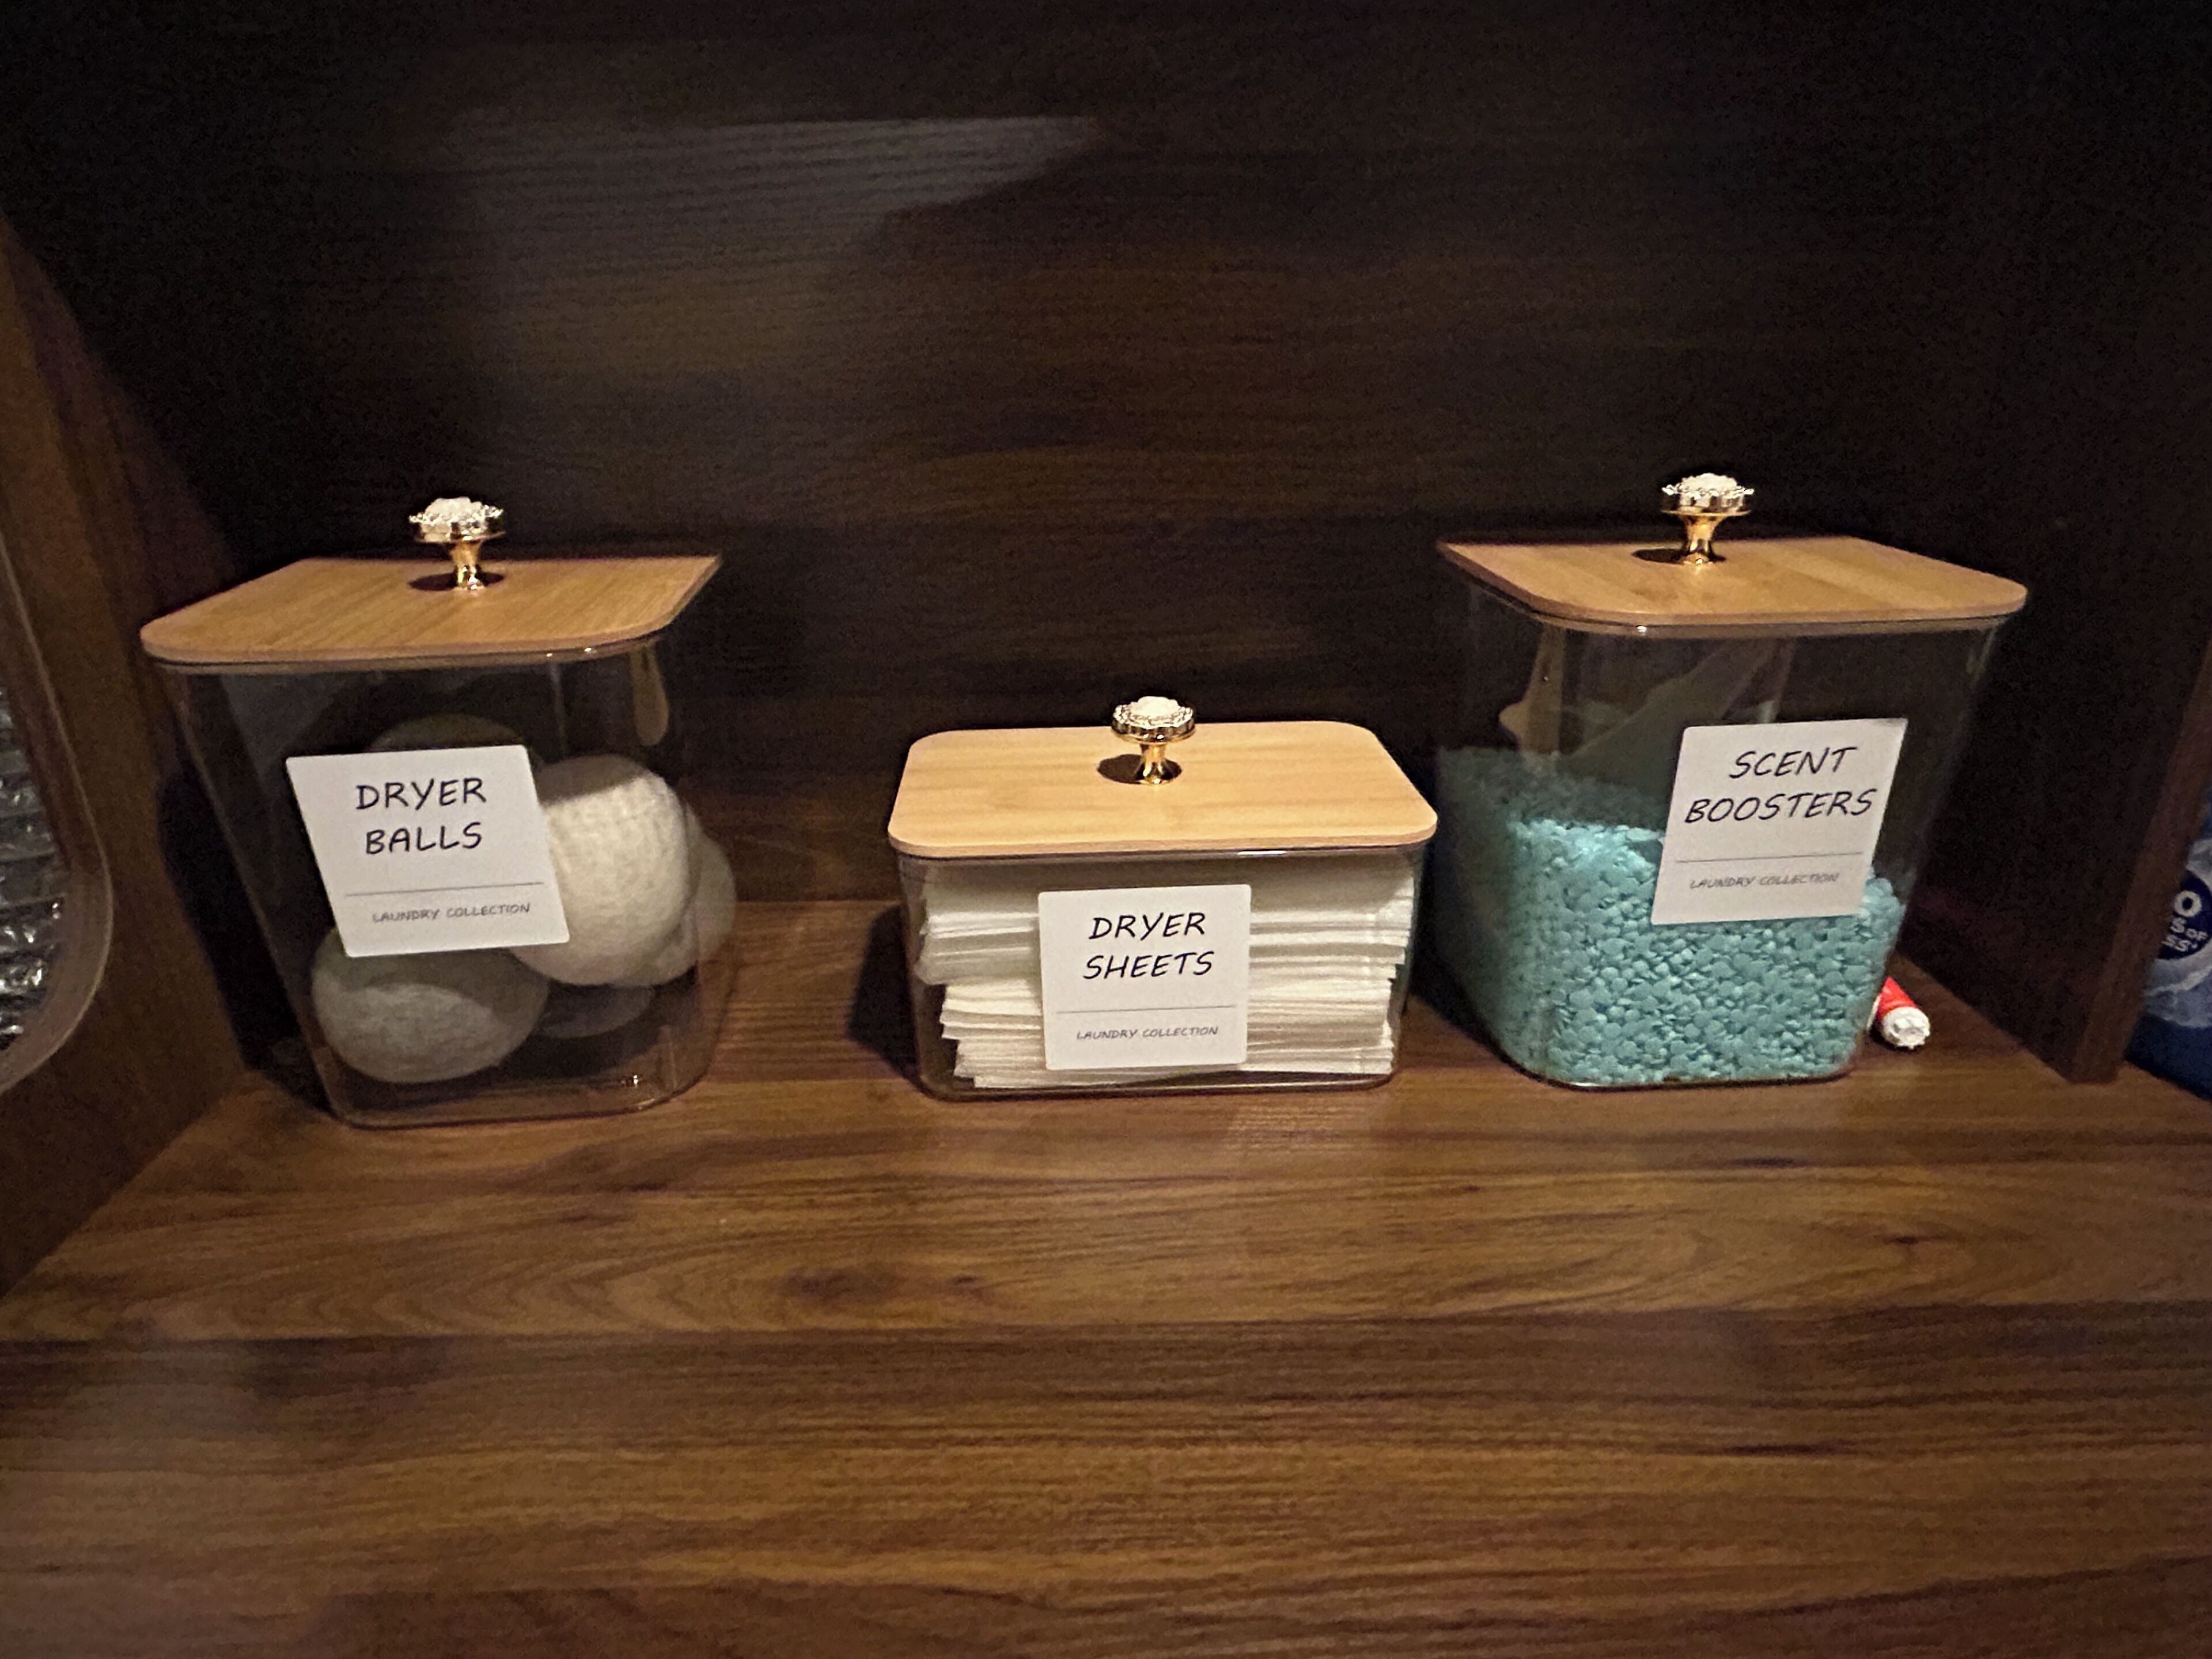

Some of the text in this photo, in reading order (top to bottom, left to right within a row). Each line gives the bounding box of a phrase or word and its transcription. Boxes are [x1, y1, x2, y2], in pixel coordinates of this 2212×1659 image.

[1728, 746, 1858, 779] SCENT
[355, 777, 487, 811] DRYER
[1684, 787, 1878, 824] BOOSTERS
[365, 821, 483, 855] BALLS
[1690, 872, 1840, 890] LAUNDRY COLLECTION
[372, 903, 531, 923] LAUNDRY COLLECTION
[1088, 912, 1206, 941] DRYER
[1082, 950, 1215, 980] SHEETS
[1076, 1026, 1219, 1040] LAUNDRY COLLECTION
